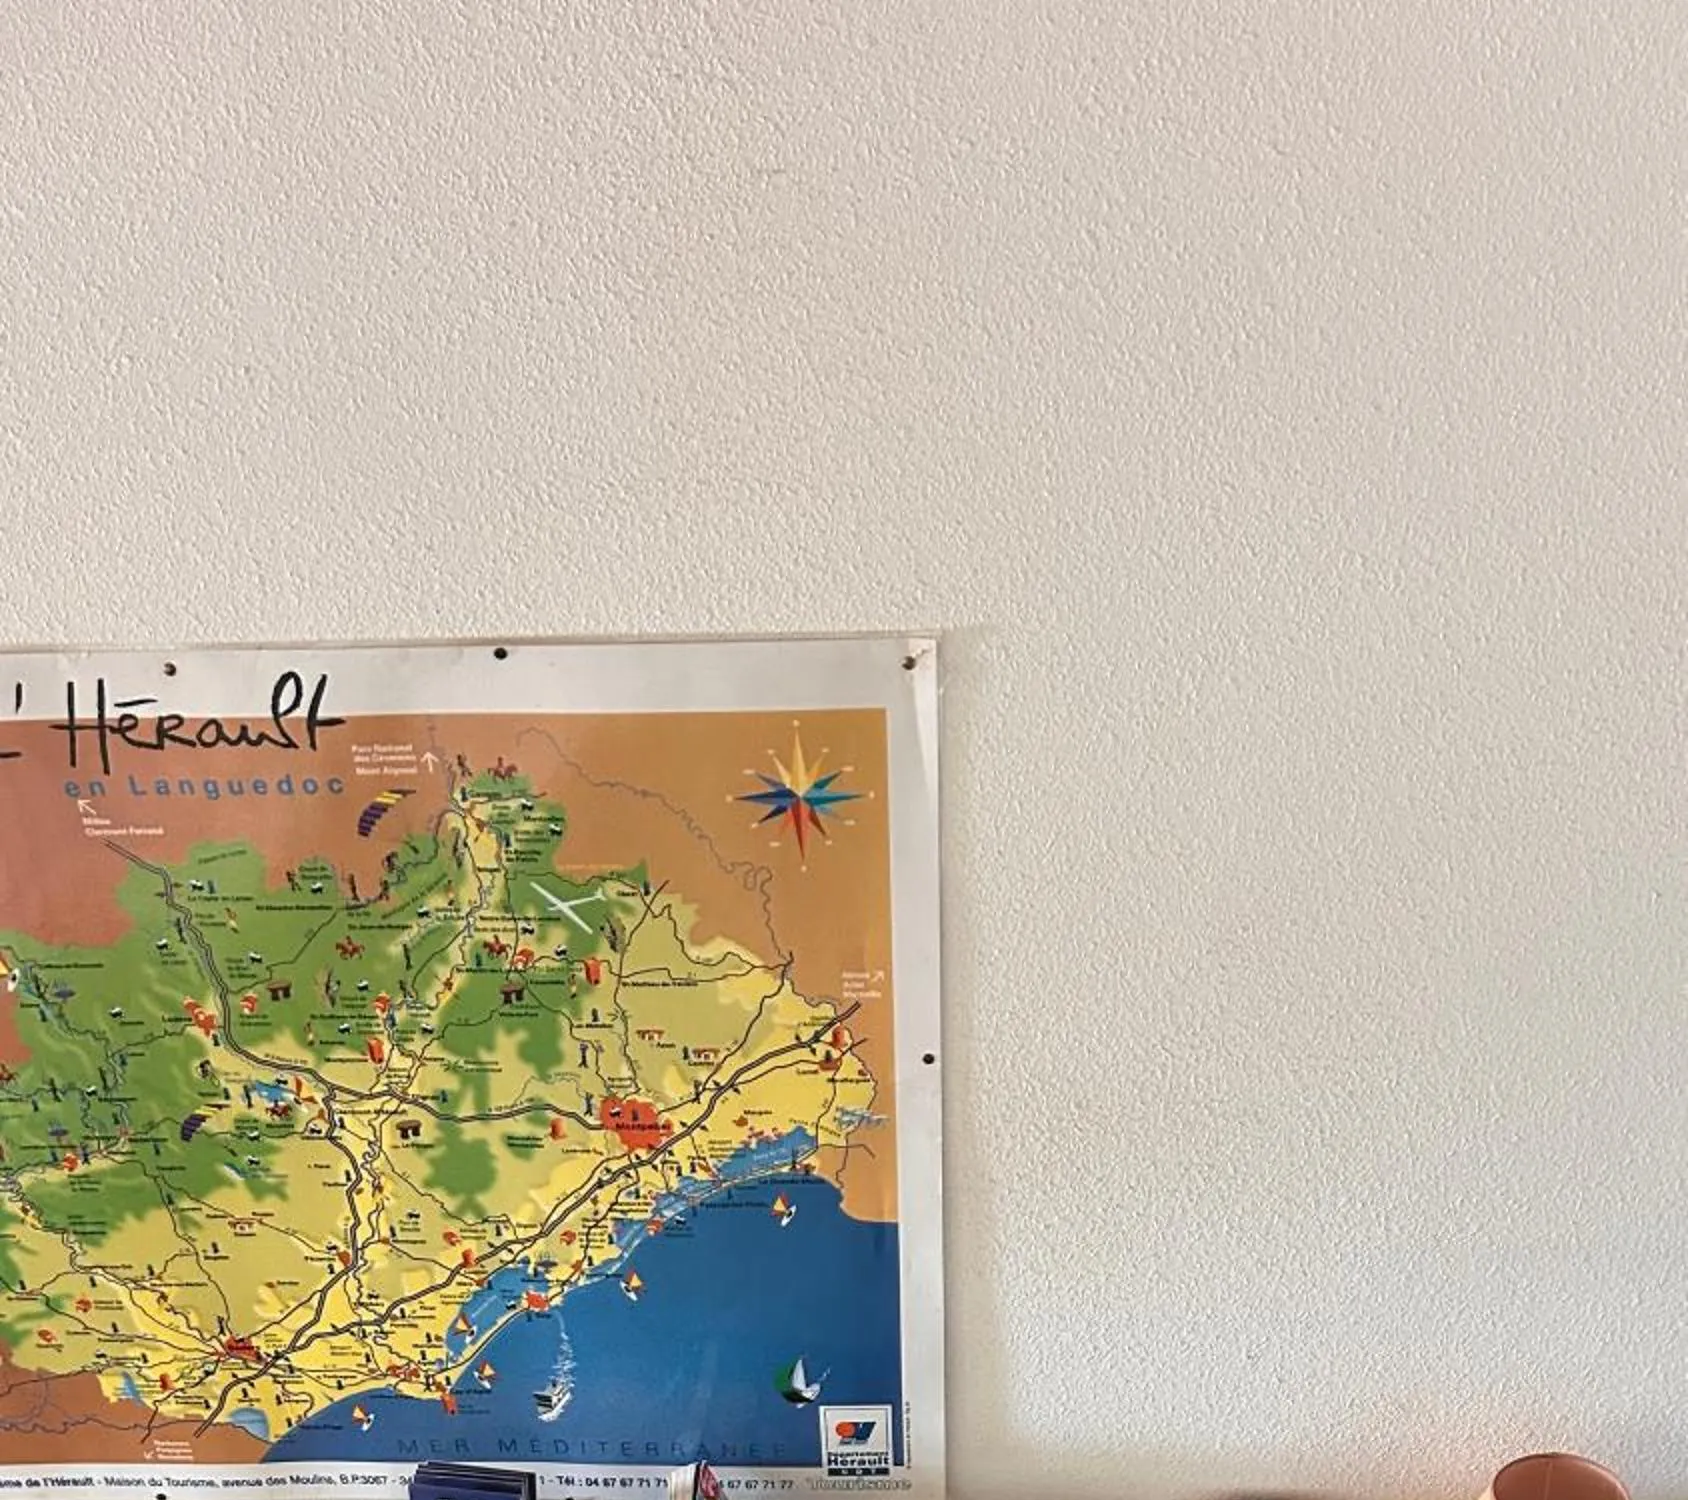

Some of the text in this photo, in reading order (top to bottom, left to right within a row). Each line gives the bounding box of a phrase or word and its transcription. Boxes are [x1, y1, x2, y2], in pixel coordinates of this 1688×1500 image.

[65, 774, 346, 800] en Languedoc
[104, 1477, 146, 1487] Maison
[149, 1478, 163, 1487] du
[222, 1479, 262, 1487] avenue
[265, 1475, 287, 1486] des
[585, 1476, 599, 1487] 04
[603, 1478, 617, 1488] 67
[620, 1478, 634, 1488] 67
[637, 1478, 651, 1488] 71
